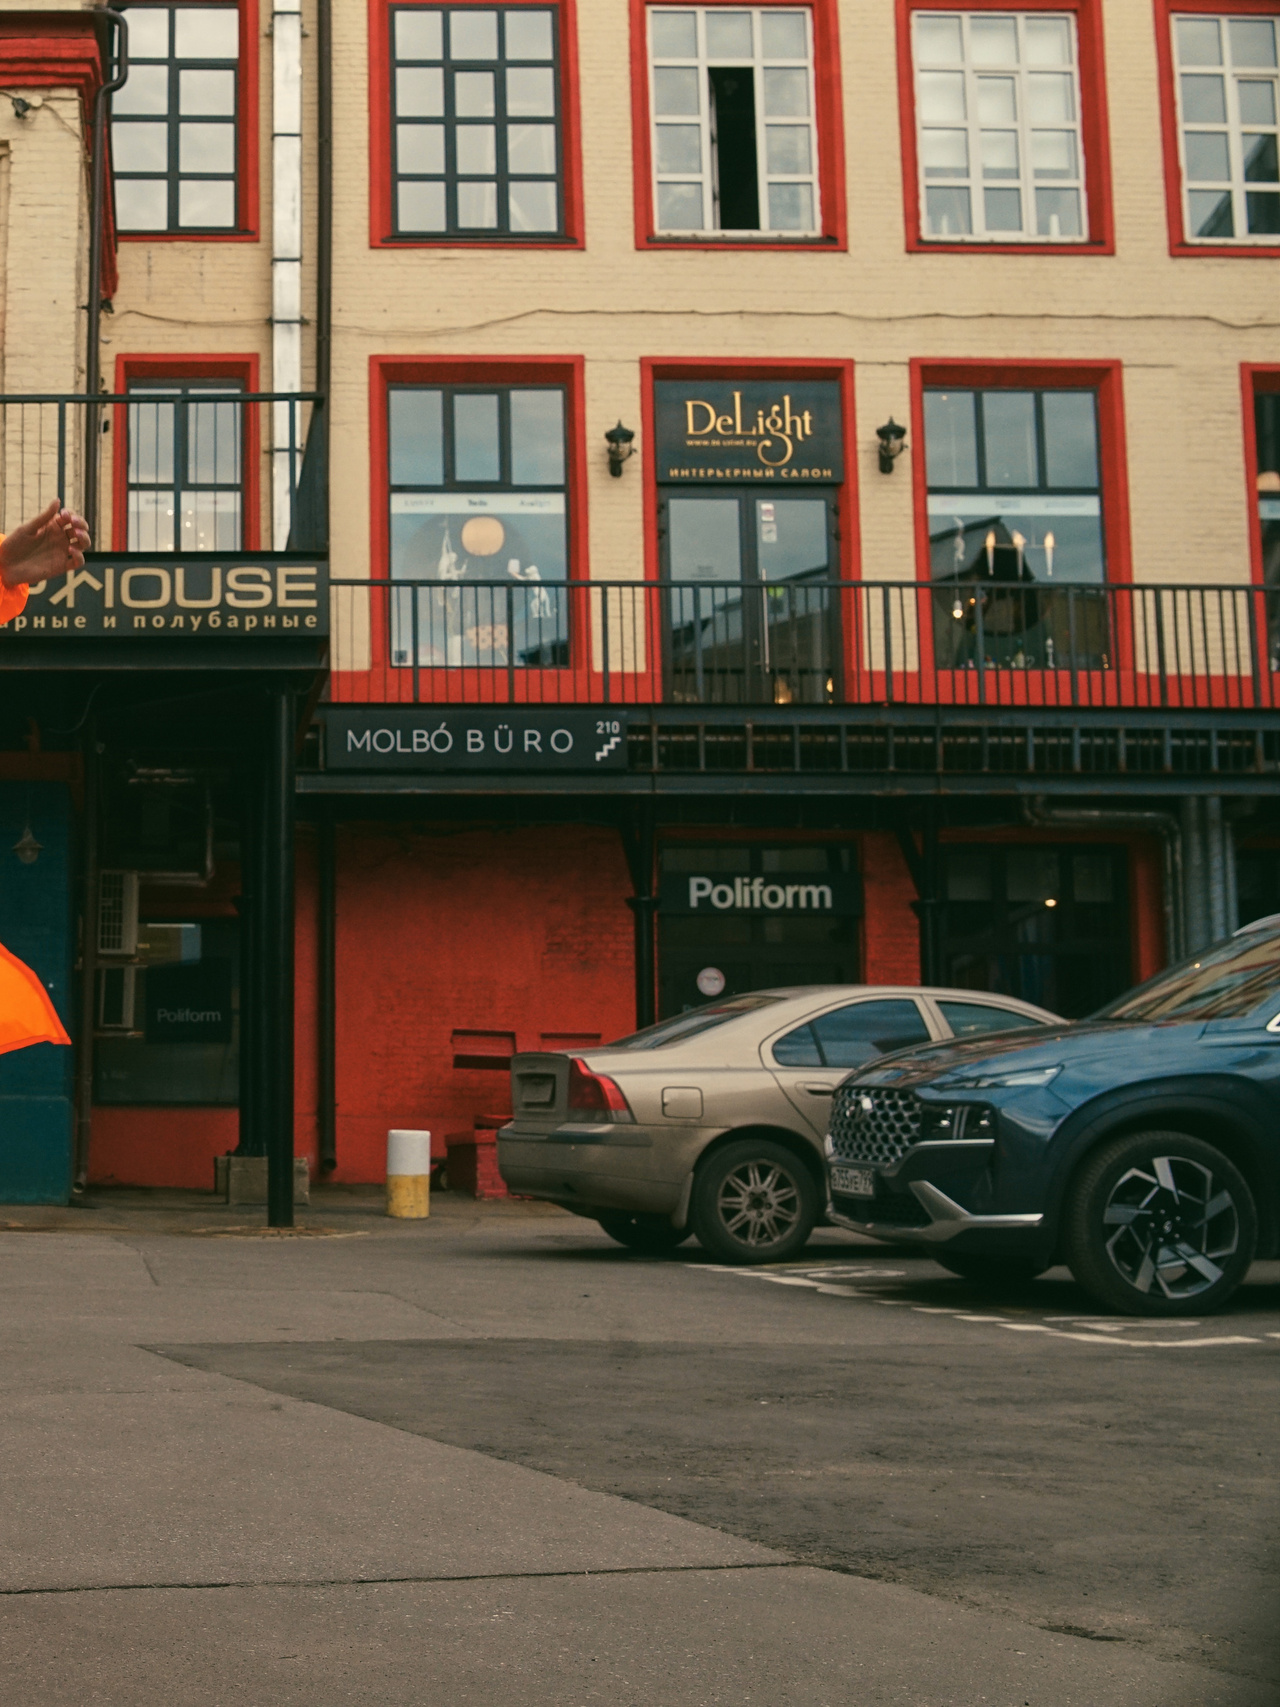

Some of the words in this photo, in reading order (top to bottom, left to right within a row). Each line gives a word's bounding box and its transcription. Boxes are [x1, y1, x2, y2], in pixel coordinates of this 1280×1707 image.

[685, 391, 813, 467] DeLight
[670, 467, 774, 478] ИНТЕРЬЕРНЫЙ
[781, 468, 832, 478] САЛОН
[103, 615, 117, 628] и
[133, 611, 317, 632] полубарные
[347, 722, 453, 752] MOLBÓ
[467, 724, 574, 752] BÜRO
[596, 721, 619, 734] 210
[689, 877, 832, 909] Poliform
[157, 1008, 221, 1023] Poliform
